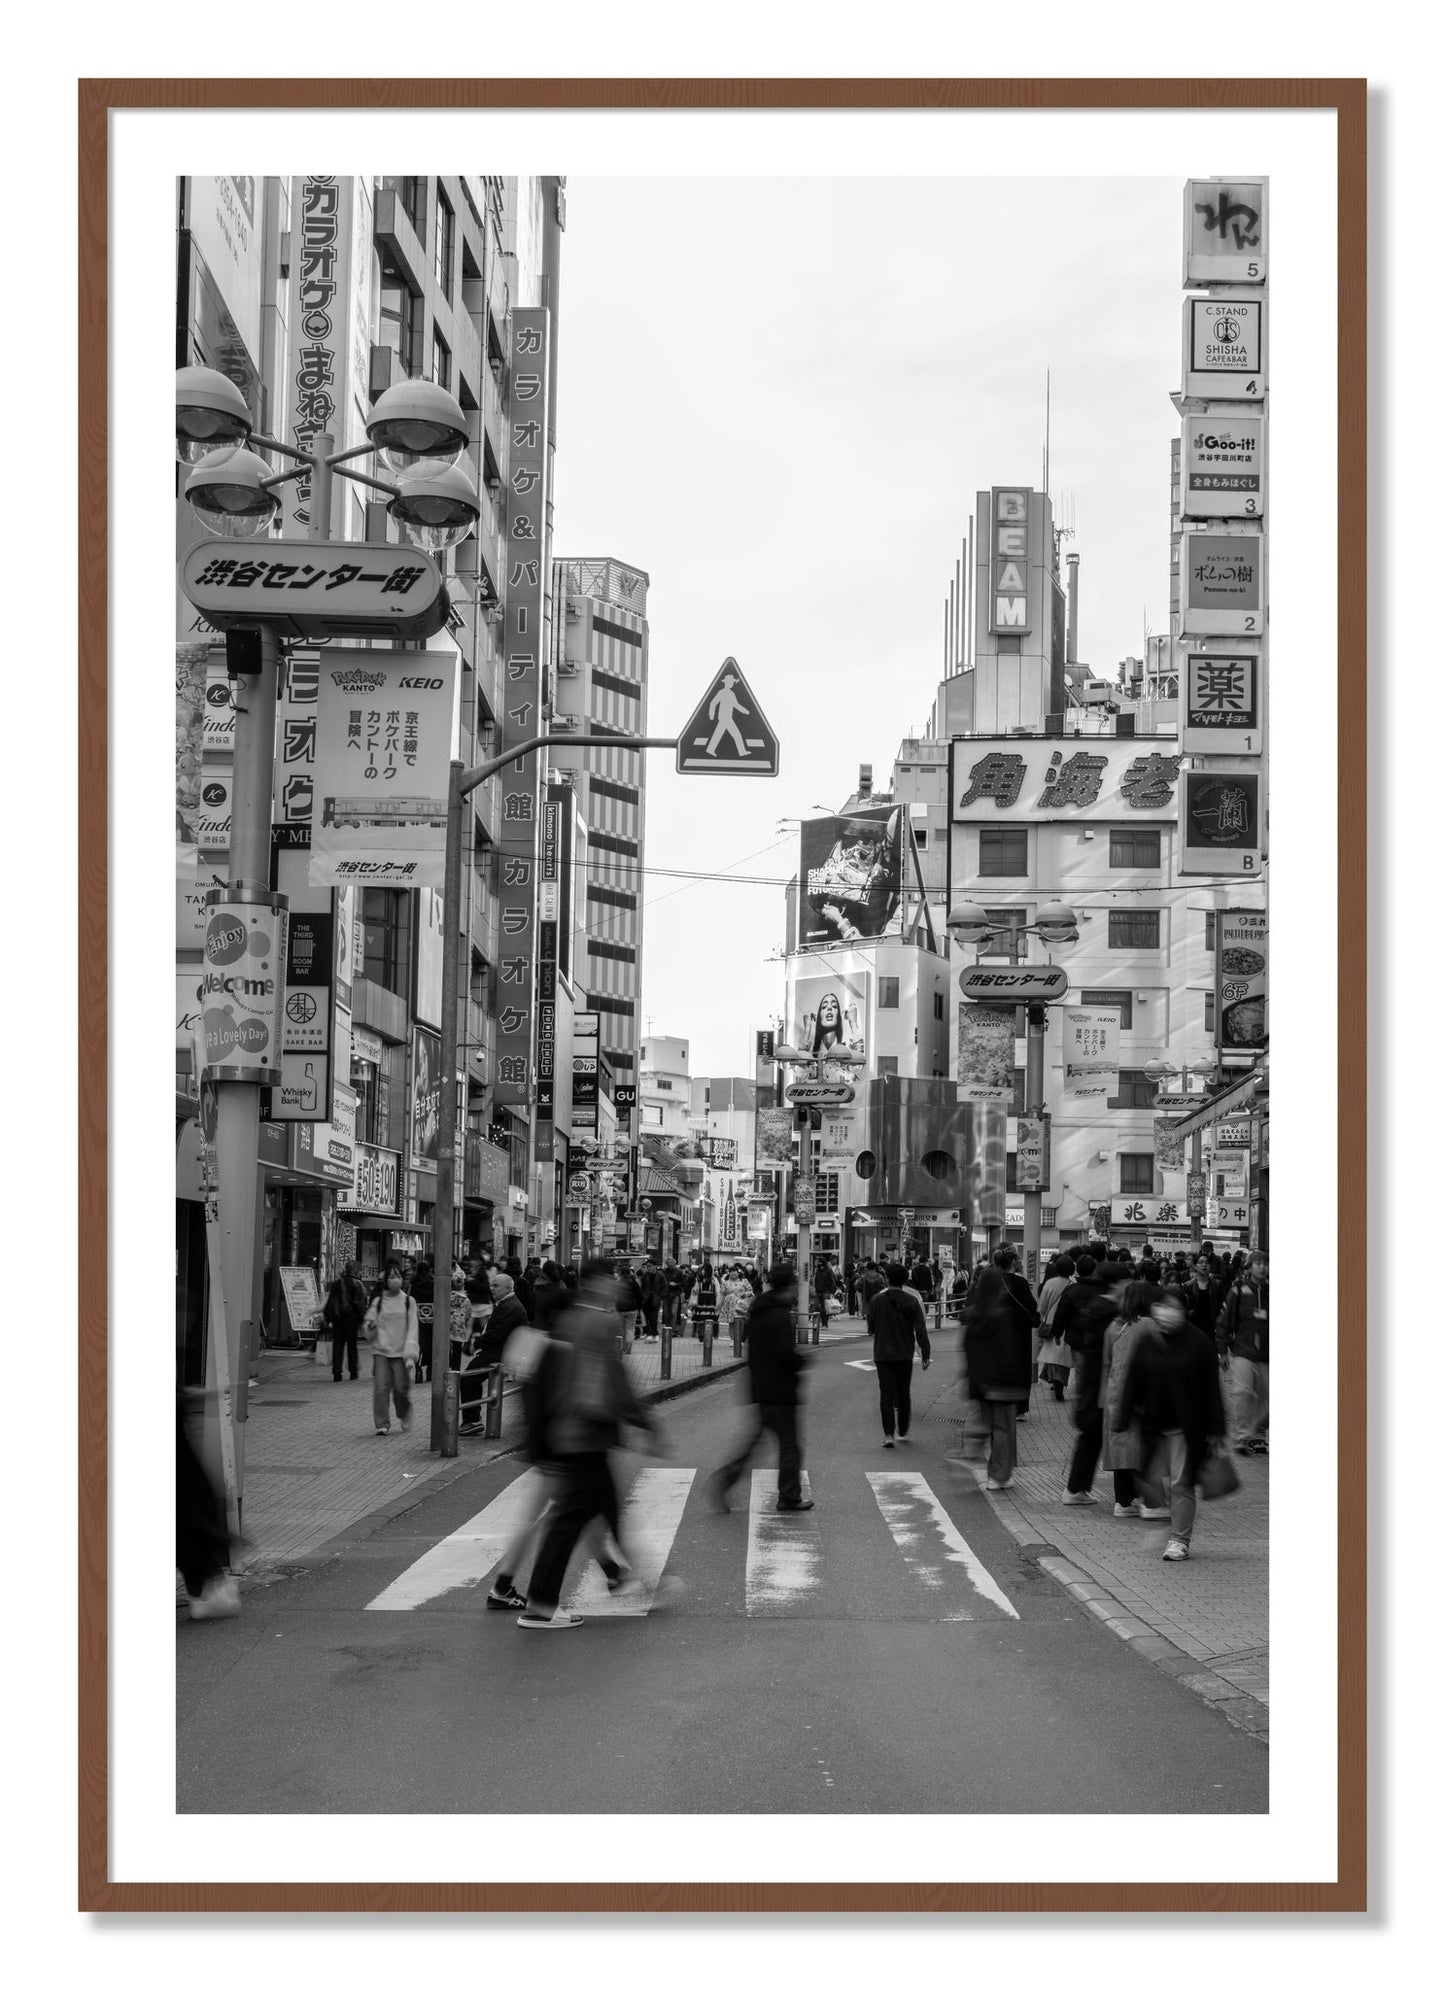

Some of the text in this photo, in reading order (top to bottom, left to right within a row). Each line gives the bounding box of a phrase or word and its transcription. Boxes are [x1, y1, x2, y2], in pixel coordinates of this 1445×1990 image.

[300, 183, 338, 314] カラオケ
[1247, 262, 1259, 277] 5
[1205, 306, 1248, 316] C.STAND
[1206, 344, 1248, 354] SHISHA
[1205, 354, 1248, 363] CAFE&BAR
[1245, 380, 1257, 394] 4
[1204, 435, 1256, 450] Goo-it!
[1193, 477, 1256, 488] 全身もみほぐし
[1245, 498, 1257, 514] 3
[996, 492, 1028, 626] BEAM
[195, 558, 428, 594] 渋谷センター街
[1194, 564, 1254, 583] ポムの樹
[1244, 616, 1256, 631] 2
[342, 684, 376, 692] KANTO
[398, 676, 445, 690] KEIO
[1197, 661, 1245, 710] 薬
[346, 710, 362, 750] 冒険へ
[363, 710, 382, 780] カントーの
[402, 711, 420, 767] 京王線で
[1244, 735, 1252, 751] 1
[960, 751, 1183, 809] 角海老
[546, 807, 555, 840] kimono
[335, 861, 418, 875] 渋谷センター街
[1243, 855, 1254, 870] B
[293, 931, 314, 939] THIRD
[296, 924, 311, 932] THE
[1223, 929, 1264, 941] 四川料理
[206, 925, 244, 959] Enjoy
[292, 957, 313, 965] ROOM
[295, 967, 310, 975] BAR
[202, 972, 275, 997] Welcome
[966, 974, 1062, 986] 渋谷センター街
[1222, 982, 1249, 1001] 6F
[218, 1026, 248, 1046] Lovely
[247, 1027, 268, 1041] Day!
[281, 1087, 313, 1100] Whisky
[616, 1090, 635, 1101] GU
[788, 1088, 847, 1097] 渋谷センター街
[280, 1096, 301, 1105] Bank
[1124, 1201, 1180, 1223] 兆楽
[726, 1200, 735, 1240] BEER
